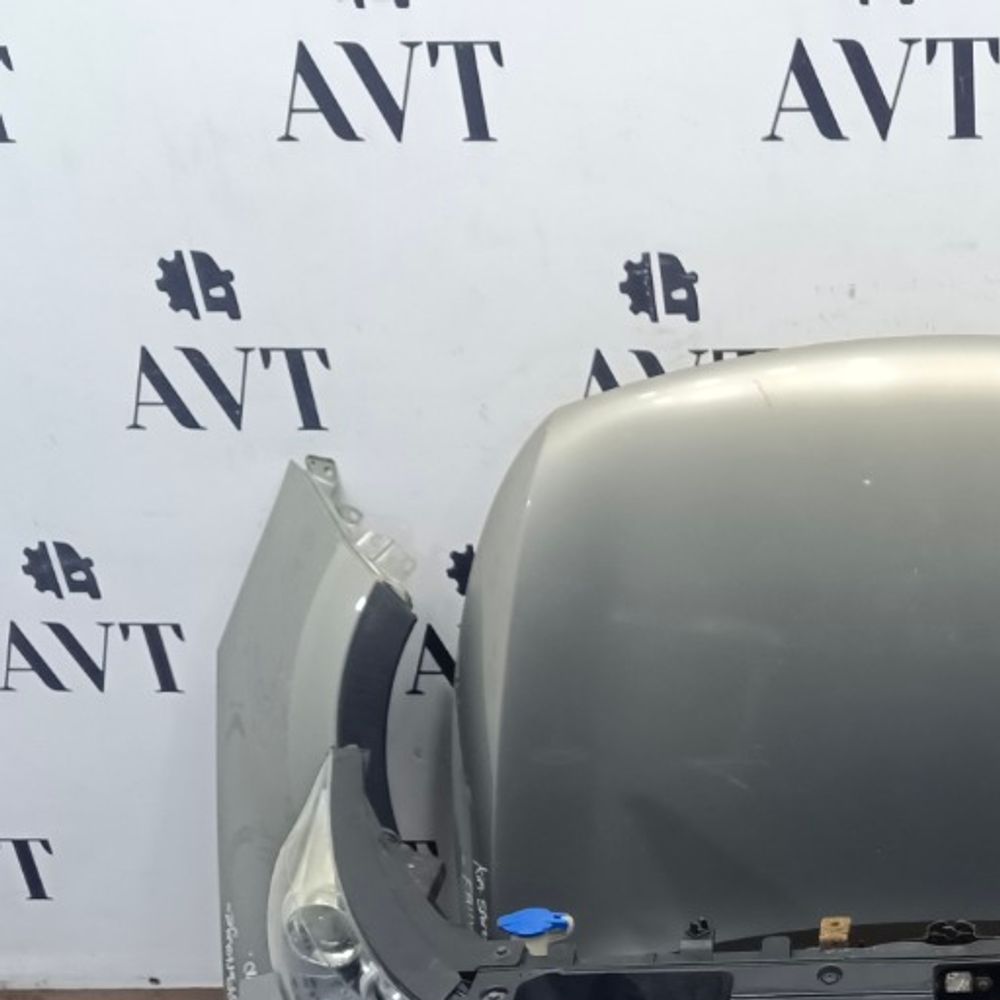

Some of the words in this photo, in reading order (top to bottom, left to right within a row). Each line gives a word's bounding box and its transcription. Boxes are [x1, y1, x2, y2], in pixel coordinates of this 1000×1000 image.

[277, 40, 504, 143] AVT
[761, 37, 1000, 141] AVT
[126, 345, 331, 431] AVT
[0, 620, 185, 693] AVT
